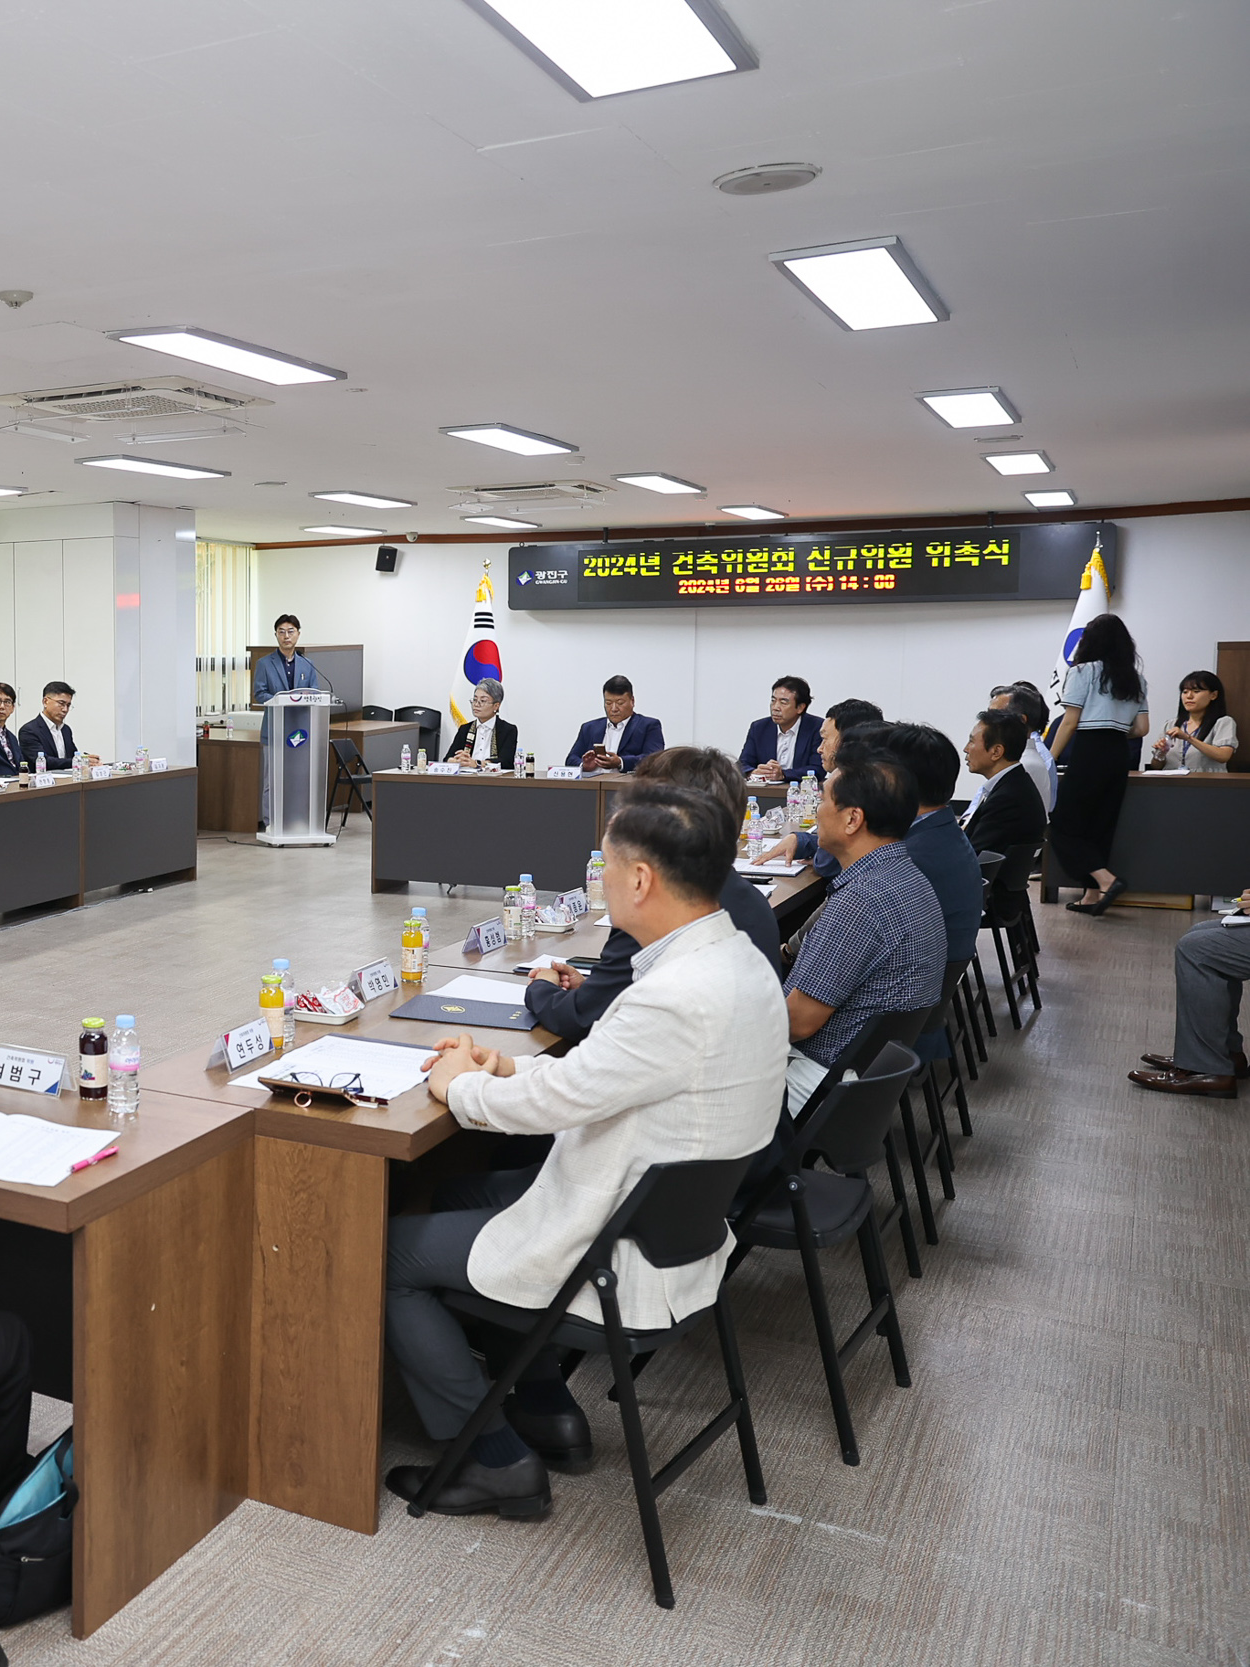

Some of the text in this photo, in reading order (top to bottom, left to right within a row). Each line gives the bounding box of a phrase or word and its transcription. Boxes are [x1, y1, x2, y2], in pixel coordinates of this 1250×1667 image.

[583, 539, 1010, 577] 2024년 건축위원회 신규위원 위촉식
[535, 570, 569, 580] 광진구
[677, 578, 730, 594] 2024년
[838, 575, 859, 590] 14
[873, 574, 895, 590] 00
